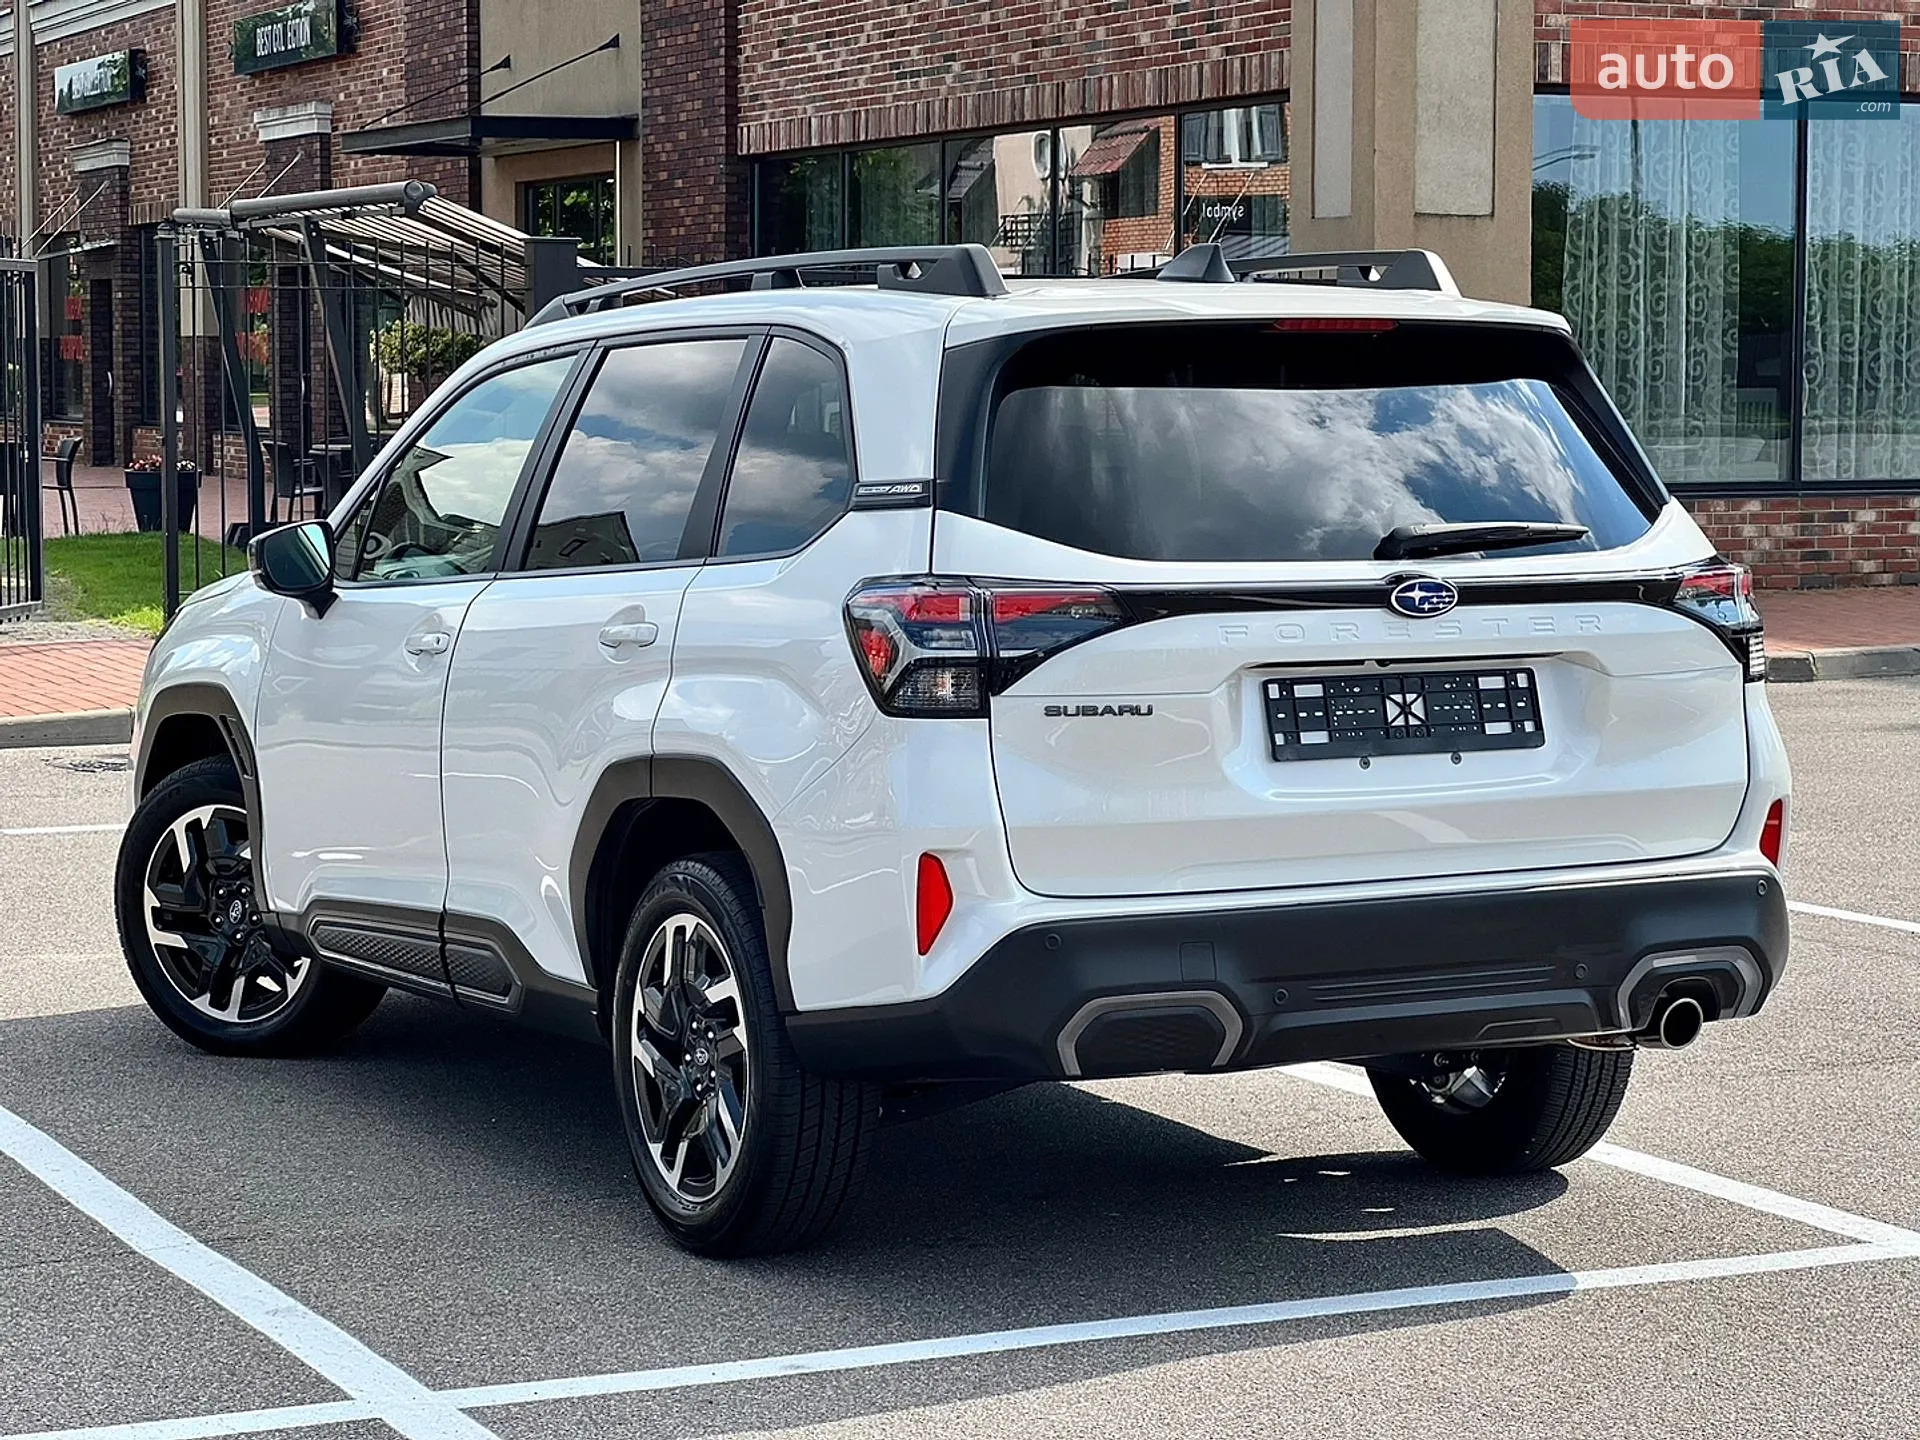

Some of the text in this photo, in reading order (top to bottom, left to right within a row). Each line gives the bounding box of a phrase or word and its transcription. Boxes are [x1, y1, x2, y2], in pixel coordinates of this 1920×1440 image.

[256, 24, 272, 57] BEST
[888, 483, 922, 494] AWD
[1219, 614, 1602, 645] FORESTER
[1044, 704, 1153, 717] SUBARU
